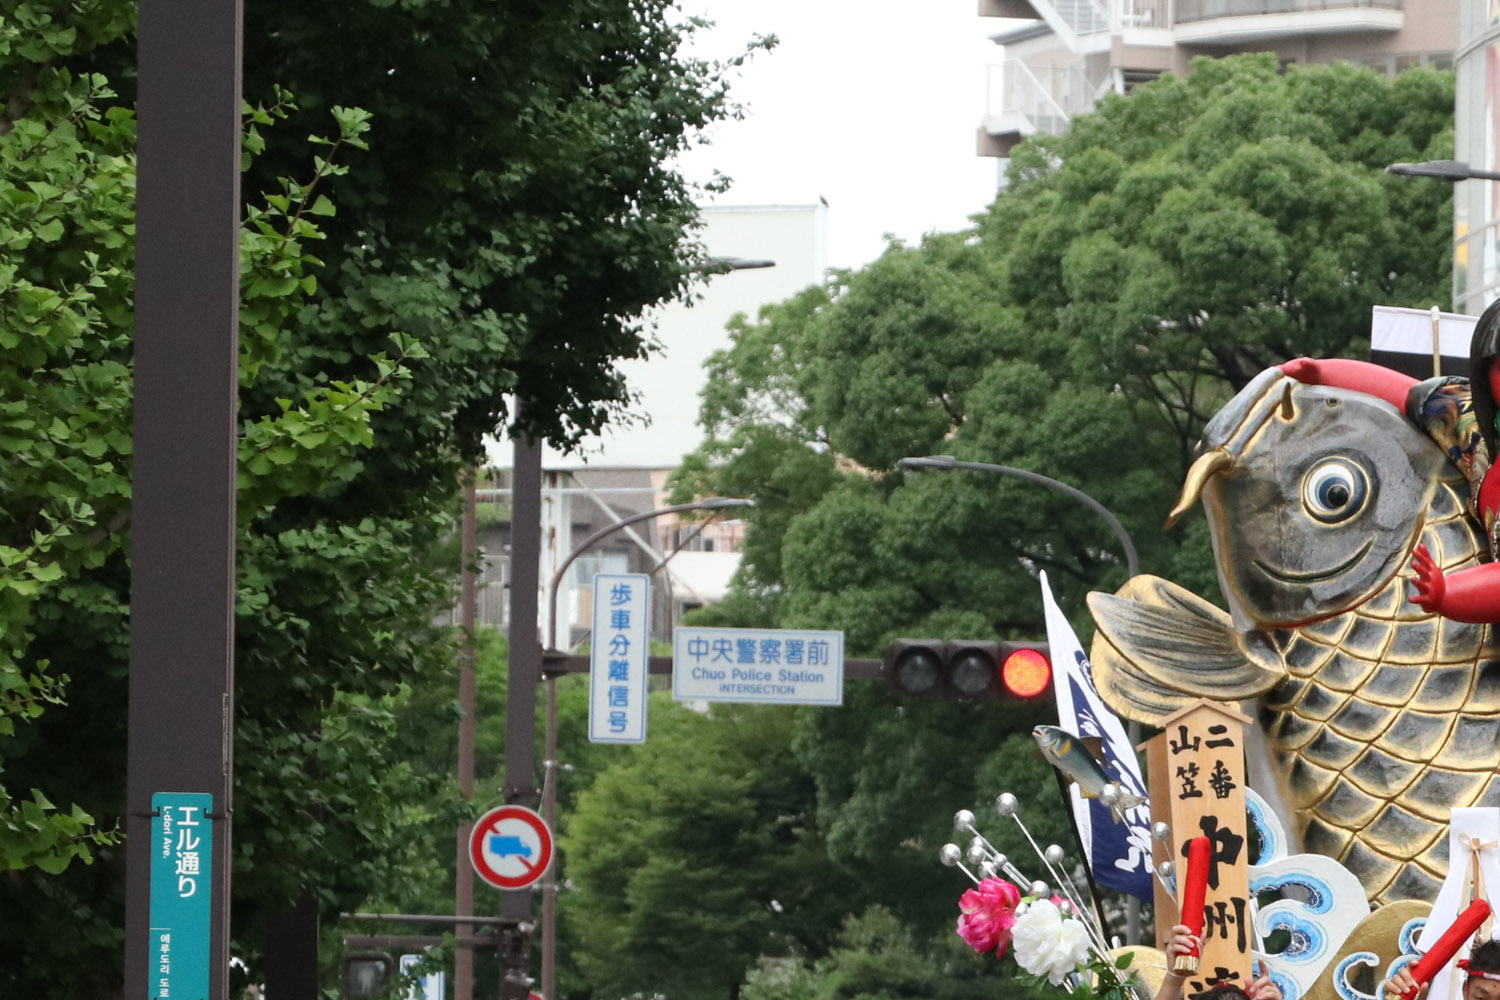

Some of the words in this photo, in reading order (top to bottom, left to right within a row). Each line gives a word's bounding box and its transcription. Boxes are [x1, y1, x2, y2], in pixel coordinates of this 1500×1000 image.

[607, 582, 632, 734] 歩車分離信号
[687, 635, 830, 666] 中央警察署前
[692, 667, 726, 680] Chuo
[732, 668, 772, 681] Police
[778, 669, 825, 683] Station
[719, 683, 796, 695] INTERSECTION
[163, 806, 174, 835] L-dori
[162, 837, 173, 859] Ave.
[174, 806, 201, 898] エル通り
[159, 933, 171, 975] 에루도리
[158, 978, 170, 998] 도로
